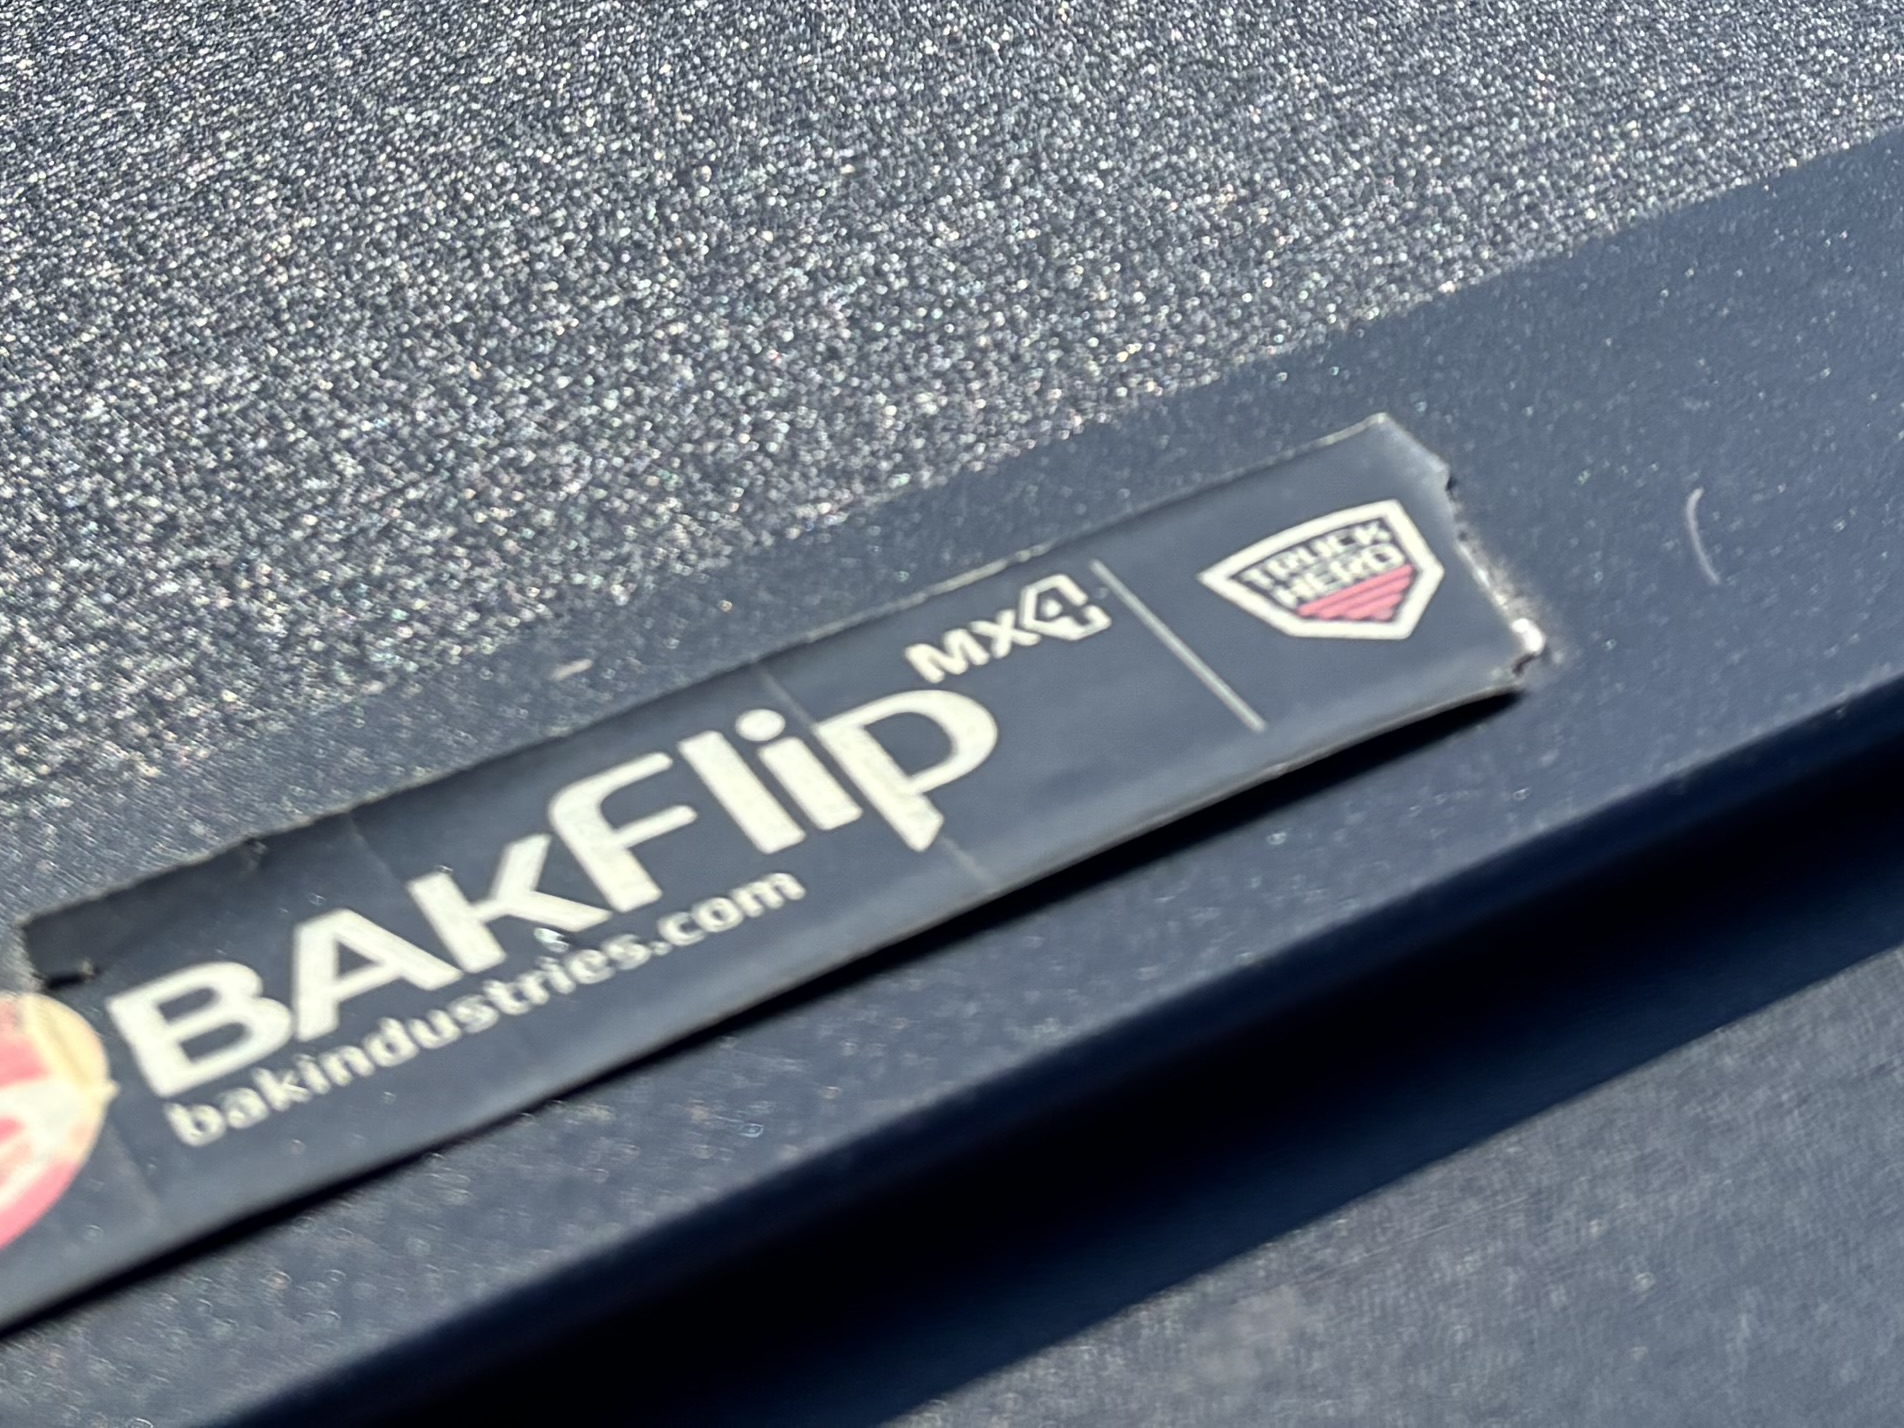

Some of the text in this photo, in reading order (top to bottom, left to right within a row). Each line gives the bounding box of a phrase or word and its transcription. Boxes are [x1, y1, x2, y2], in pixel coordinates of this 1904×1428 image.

[1240, 520, 1392, 590] TRUCK
[1272, 542, 1408, 610] HERO
[904, 573, 1111, 684] MX4
[163, 870, 808, 1148] bakindustries.com
